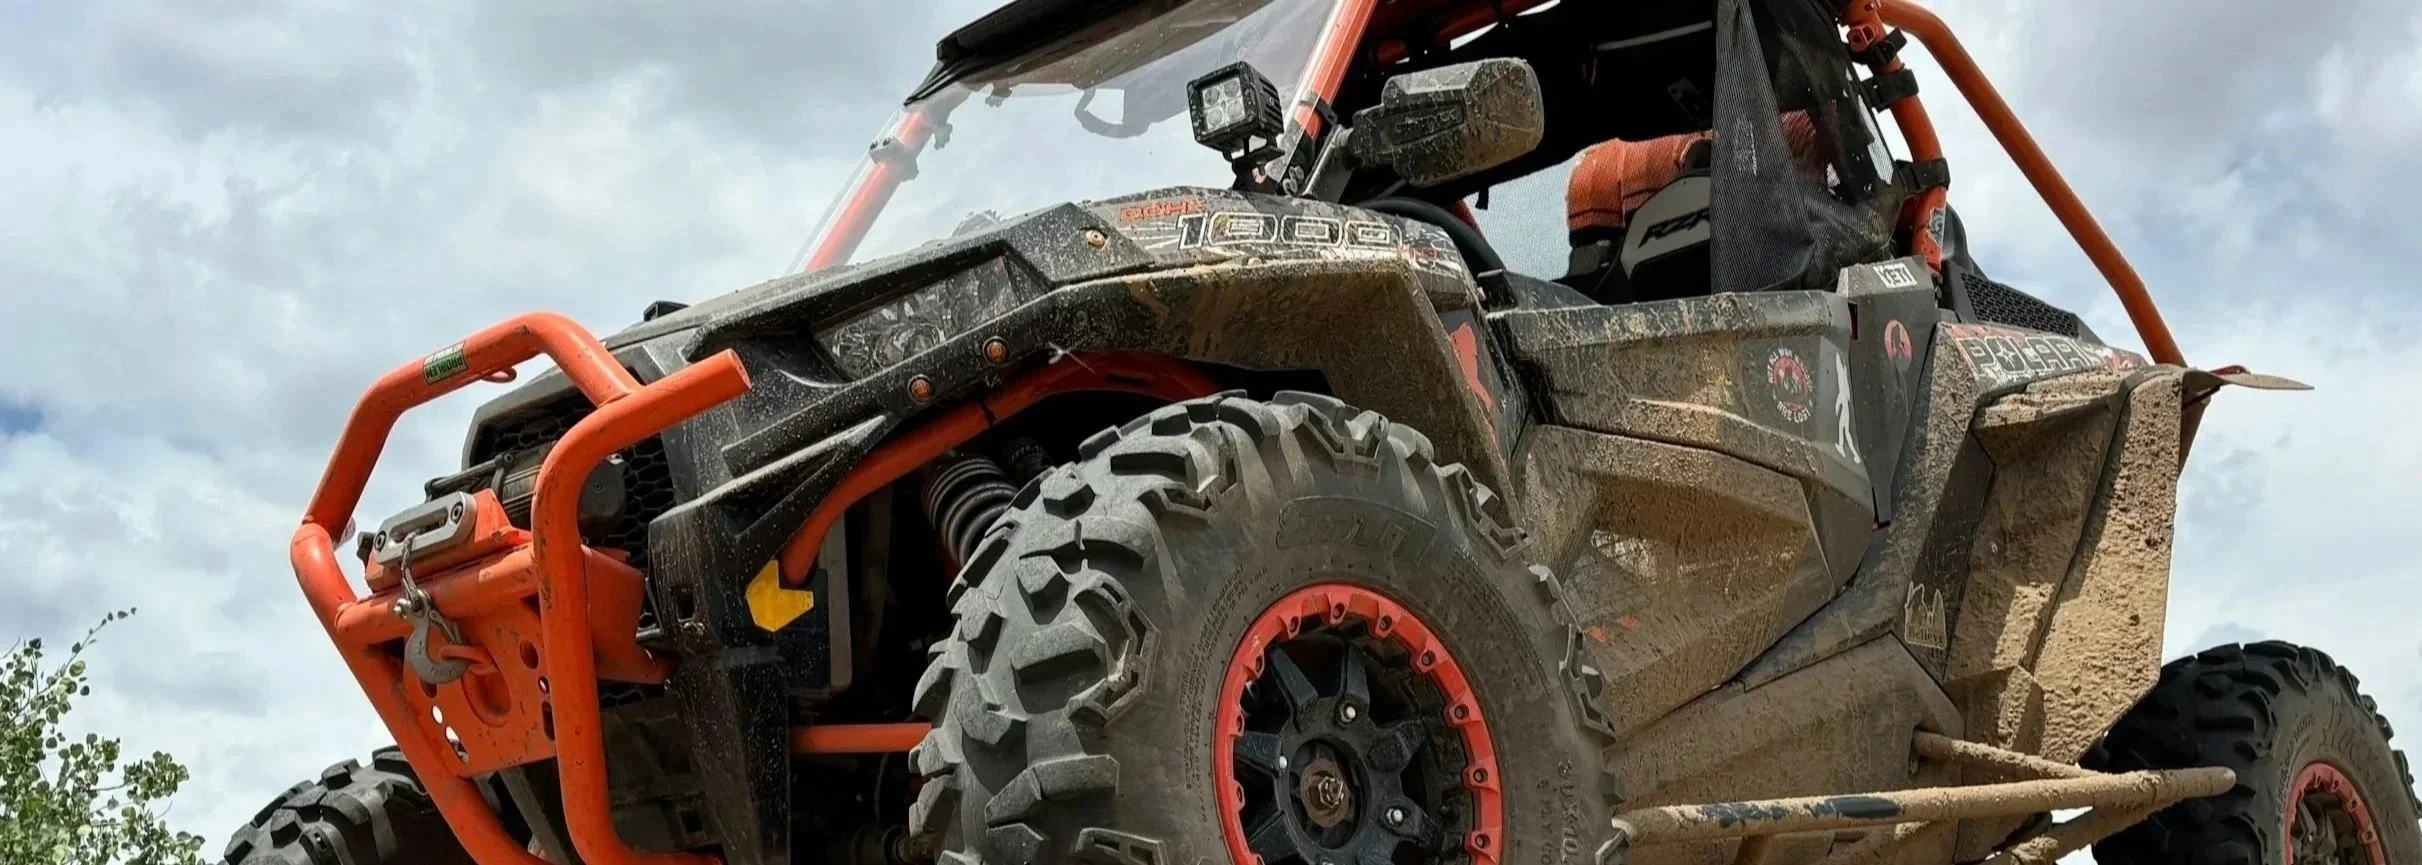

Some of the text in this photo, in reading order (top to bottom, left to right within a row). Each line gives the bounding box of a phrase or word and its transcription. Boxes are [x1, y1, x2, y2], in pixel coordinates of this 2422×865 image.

[1176, 211, 1402, 250] 1000
[1878, 265, 1914, 286] YETI
[1793, 407, 1811, 424] LOST
